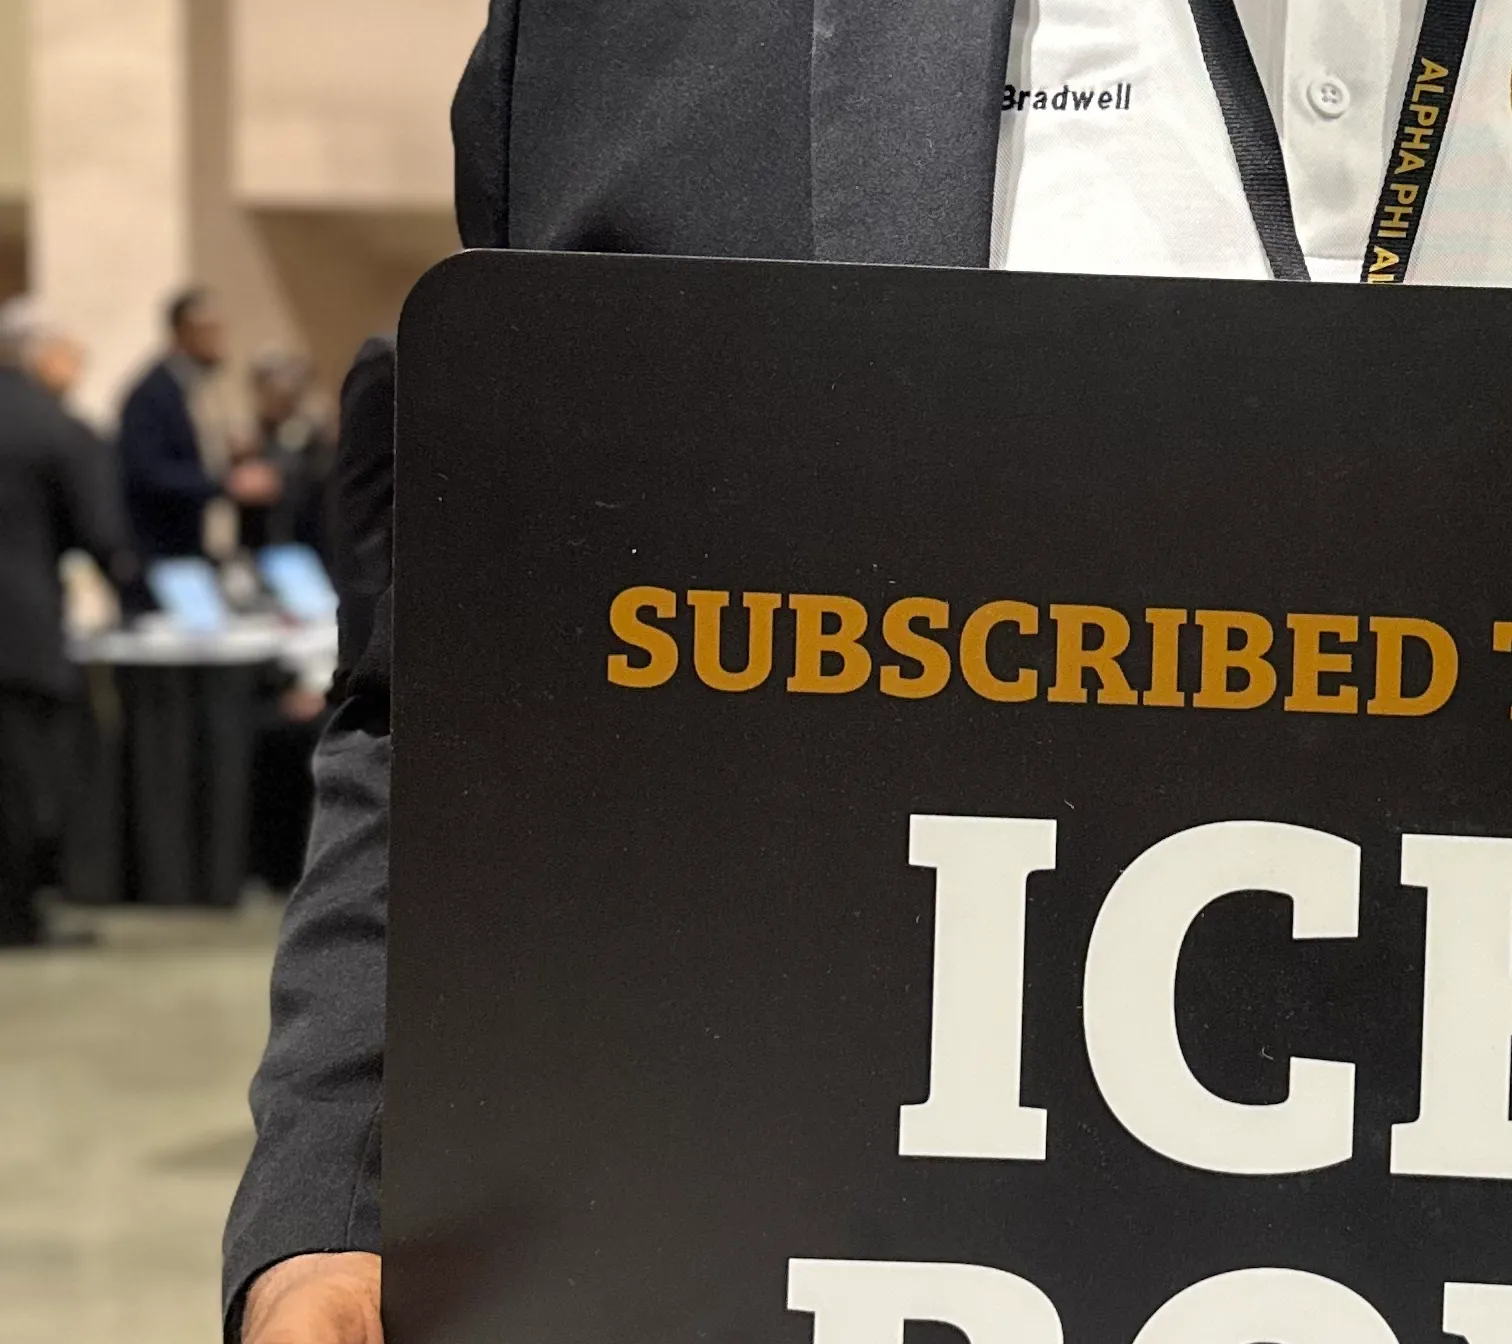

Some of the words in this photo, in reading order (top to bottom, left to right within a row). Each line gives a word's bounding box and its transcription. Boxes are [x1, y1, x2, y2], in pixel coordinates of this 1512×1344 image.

[1001, 83, 1132, 111] Bradwell
[1393, 56, 1449, 175] ALPHA
[1377, 183, 1420, 239] PHI
[606, 586, 1459, 717] SUBSCRIBED
